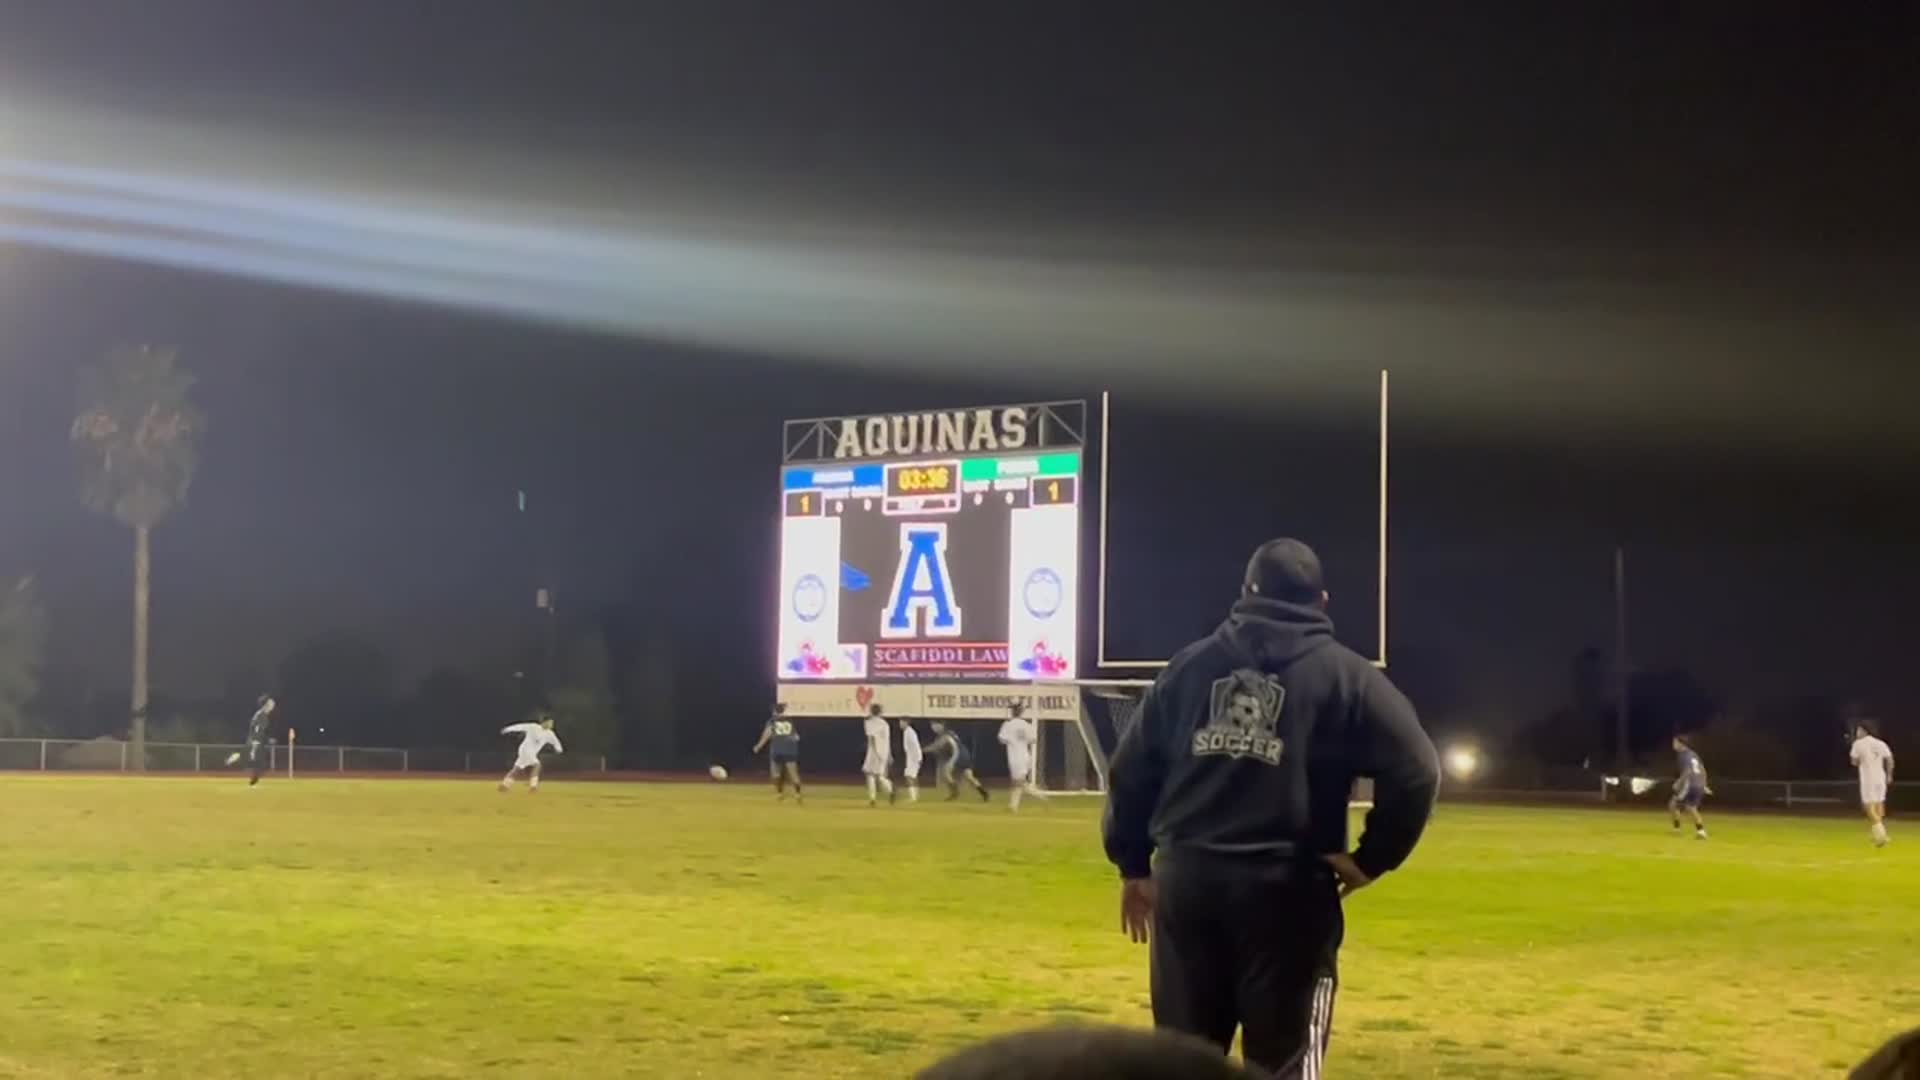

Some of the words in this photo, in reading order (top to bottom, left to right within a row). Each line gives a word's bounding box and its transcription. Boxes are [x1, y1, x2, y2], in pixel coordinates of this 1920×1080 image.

[834, 407, 1027, 458] AQUINAS
[898, 467, 949, 490] 03:36
[1048, 481, 1058, 501] 1
[800, 495, 809, 513] 1
[883, 524, 960, 637] A
[874, 648, 963, 662] SCAFIDDI
[970, 648, 1008, 662] LAW
[927, 694, 956, 708] THE
[1194, 731, 1282, 761] SOCCER
